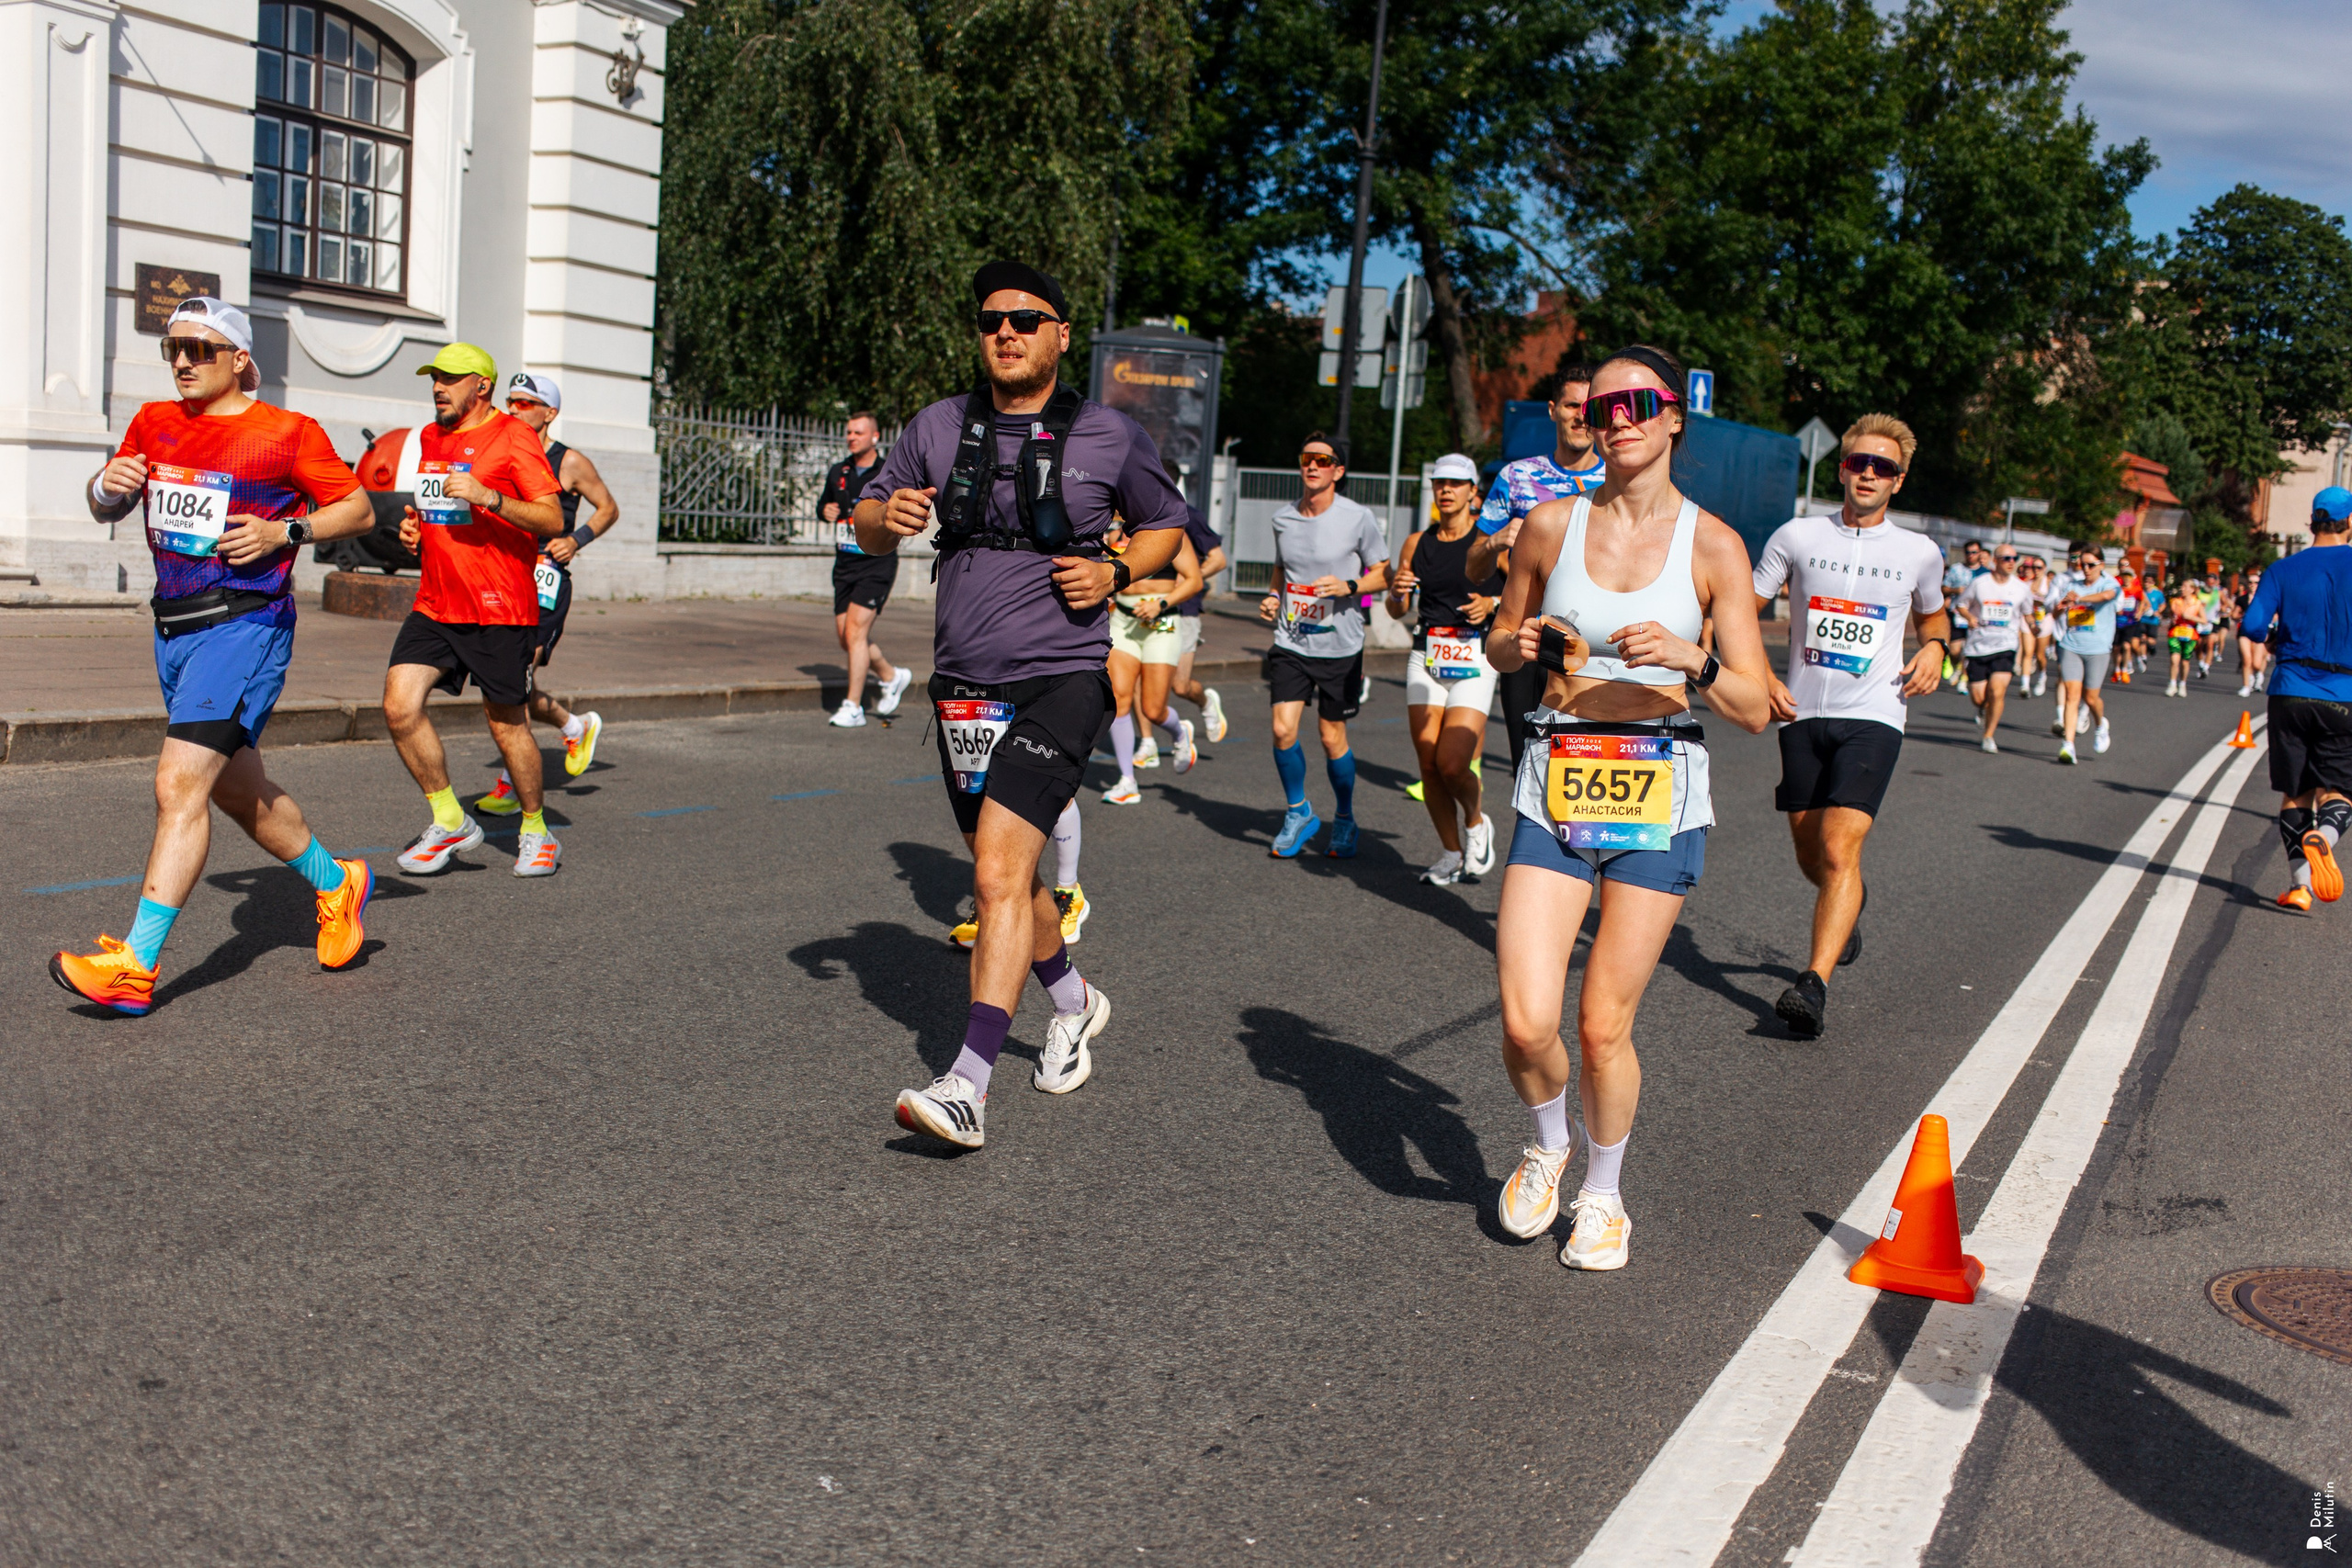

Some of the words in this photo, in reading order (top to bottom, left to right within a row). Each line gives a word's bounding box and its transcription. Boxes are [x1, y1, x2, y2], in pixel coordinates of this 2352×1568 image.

[193, 474, 205, 483] 21,1
[422, 479, 459, 499] 20
[156, 489, 213, 522] 1084
[164, 518, 194, 529] АНДРЕЙ
[1293, 601, 1325, 620] 7821
[1816, 617, 1873, 645] 6588
[1432, 644, 1474, 661] 7822
[1831, 642, 1852, 650] ИЛЬЯ
[1811, 649, 1819, 662] D
[976, 706, 988, 715] 21,1
[949, 727, 996, 756] 5669
[1620, 744, 1636, 754] 21,1
[1640, 744, 1657, 753] КМ
[960, 773, 967, 789] D
[1563, 767, 1657, 803] 5657
[1573, 805, 1642, 817] АНАСТАСИЯ
